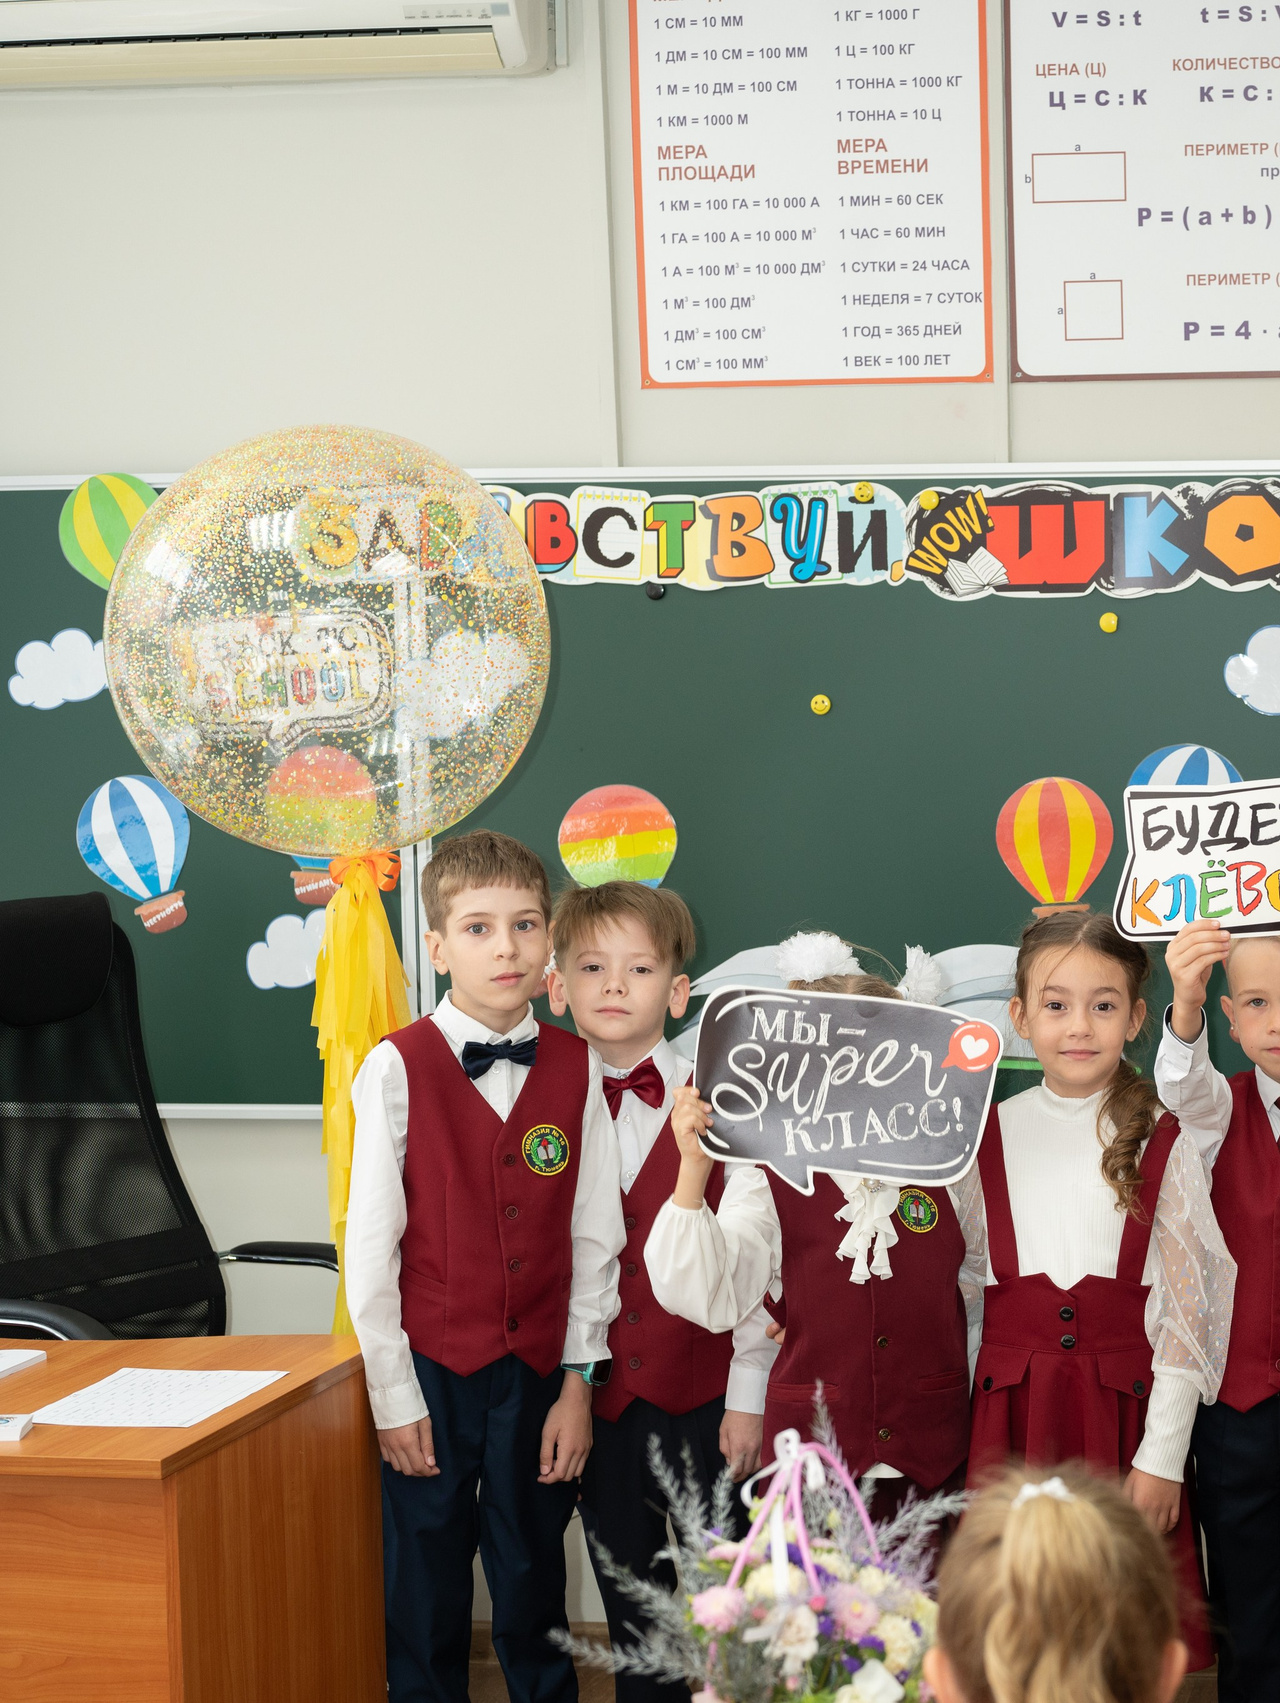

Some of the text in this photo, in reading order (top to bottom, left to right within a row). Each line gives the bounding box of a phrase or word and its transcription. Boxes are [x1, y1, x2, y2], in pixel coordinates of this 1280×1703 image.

[654, 16, 744, 30] 1 СМ 10 ММ
[833, 9, 921, 22] 1 КГ 1000 Г
[834, 43, 916, 59] 1 Ц 100 КГ
[1035, 63, 1107, 79] ЦЕНА (Ц)
[835, 75, 963, 90] 1 ТОННА 1000 КГ
[836, 109, 942, 123] 1 ТОННА 10 Ц
[657, 145, 708, 161] МЕРА
[836, 138, 888, 154] МЕРА
[1184, 143, 1269, 157] ПЕРИМЕТР
[658, 164, 756, 183] ПЛОЩАДИ
[837, 158, 929, 175] ВРЕМЕНИ
[838, 194, 944, 208] 1 МИН 60 СЕК
[839, 226, 946, 240] 1 ЧАС 60 МИН
[840, 259, 970, 273] 1 СУТКИ 24 ЧАСА
[1186, 273, 1270, 287] ПЕРИМЕТР
[841, 292, 983, 308] 1 НЕДЕЛЯ 7 СУТОК
[842, 321, 962, 339] 1 ГОД 365 ДНЕЙ
[842, 354, 951, 368] 1 ВЕК 100 ЛЕТ
[907, 489, 996, 575] WOW!
[710, 1039, 948, 1132] Super
[781, 1096, 965, 1157] КЛАСС!
